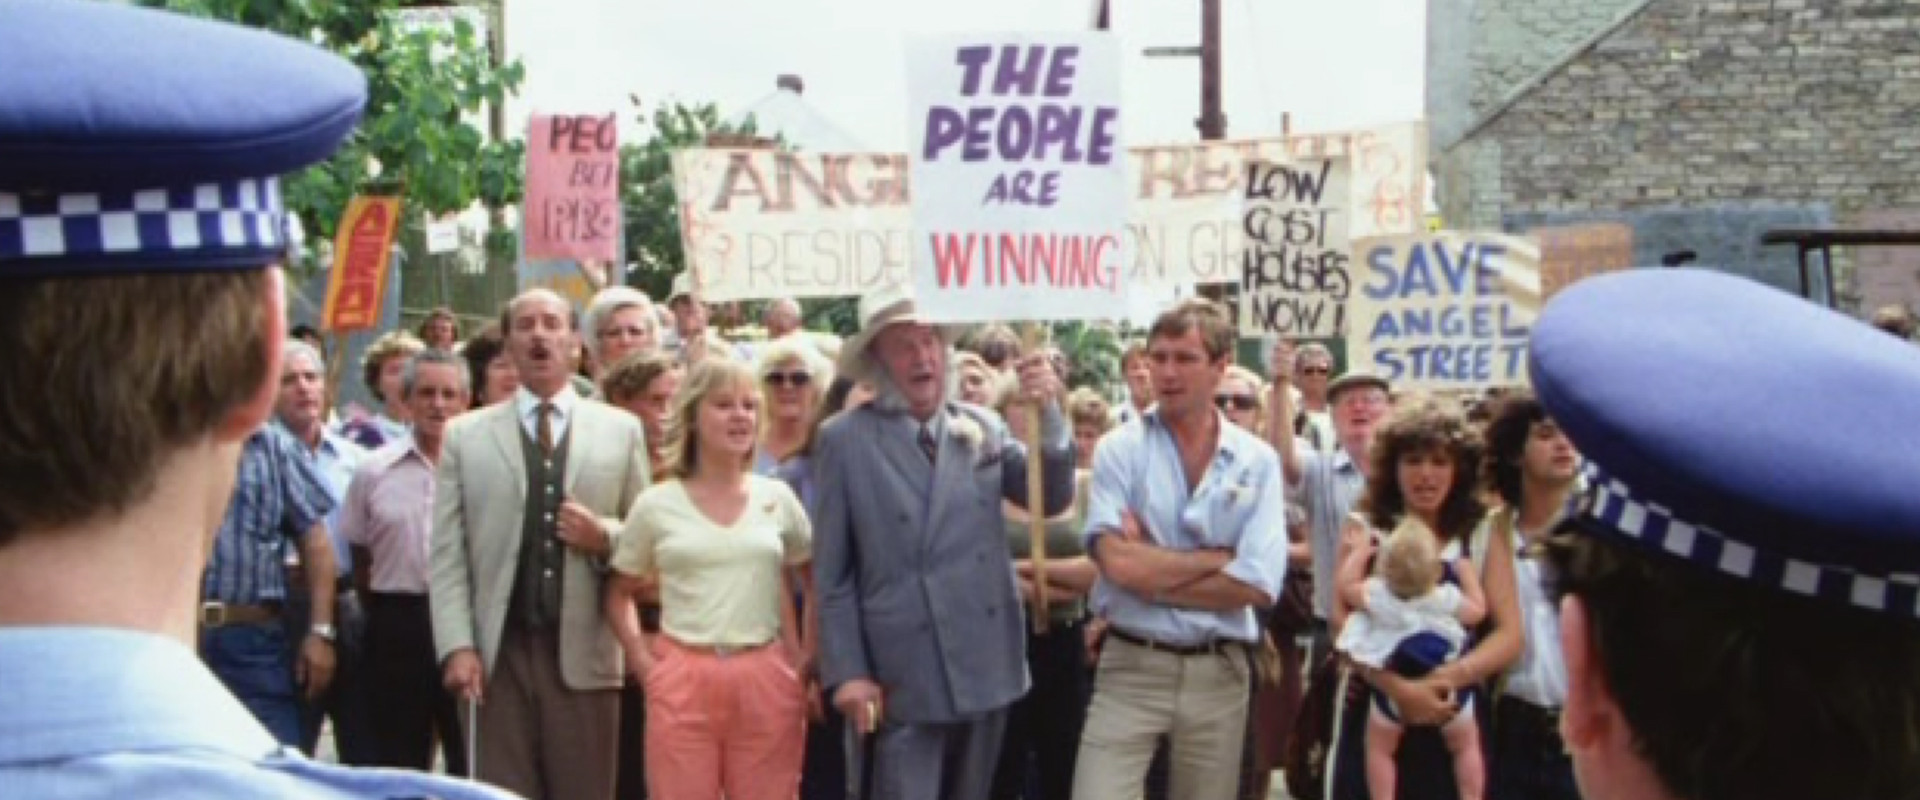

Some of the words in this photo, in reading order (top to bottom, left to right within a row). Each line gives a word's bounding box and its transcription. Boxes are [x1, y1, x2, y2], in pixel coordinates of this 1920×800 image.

[956, 44, 1080, 96] THE
[922, 105, 1118, 165] PEOPLE
[982, 171, 1060, 206] ARE
[1245, 160, 1331, 204] LOW
[1243, 207, 1342, 247] COST
[929, 232, 1120, 291] WINNING
[1242, 246, 1350, 301] HOUSES
[1362, 240, 1506, 299] SAVE
[1370, 303, 1530, 341] ANGEL
[1374, 345, 1527, 380] STREET
